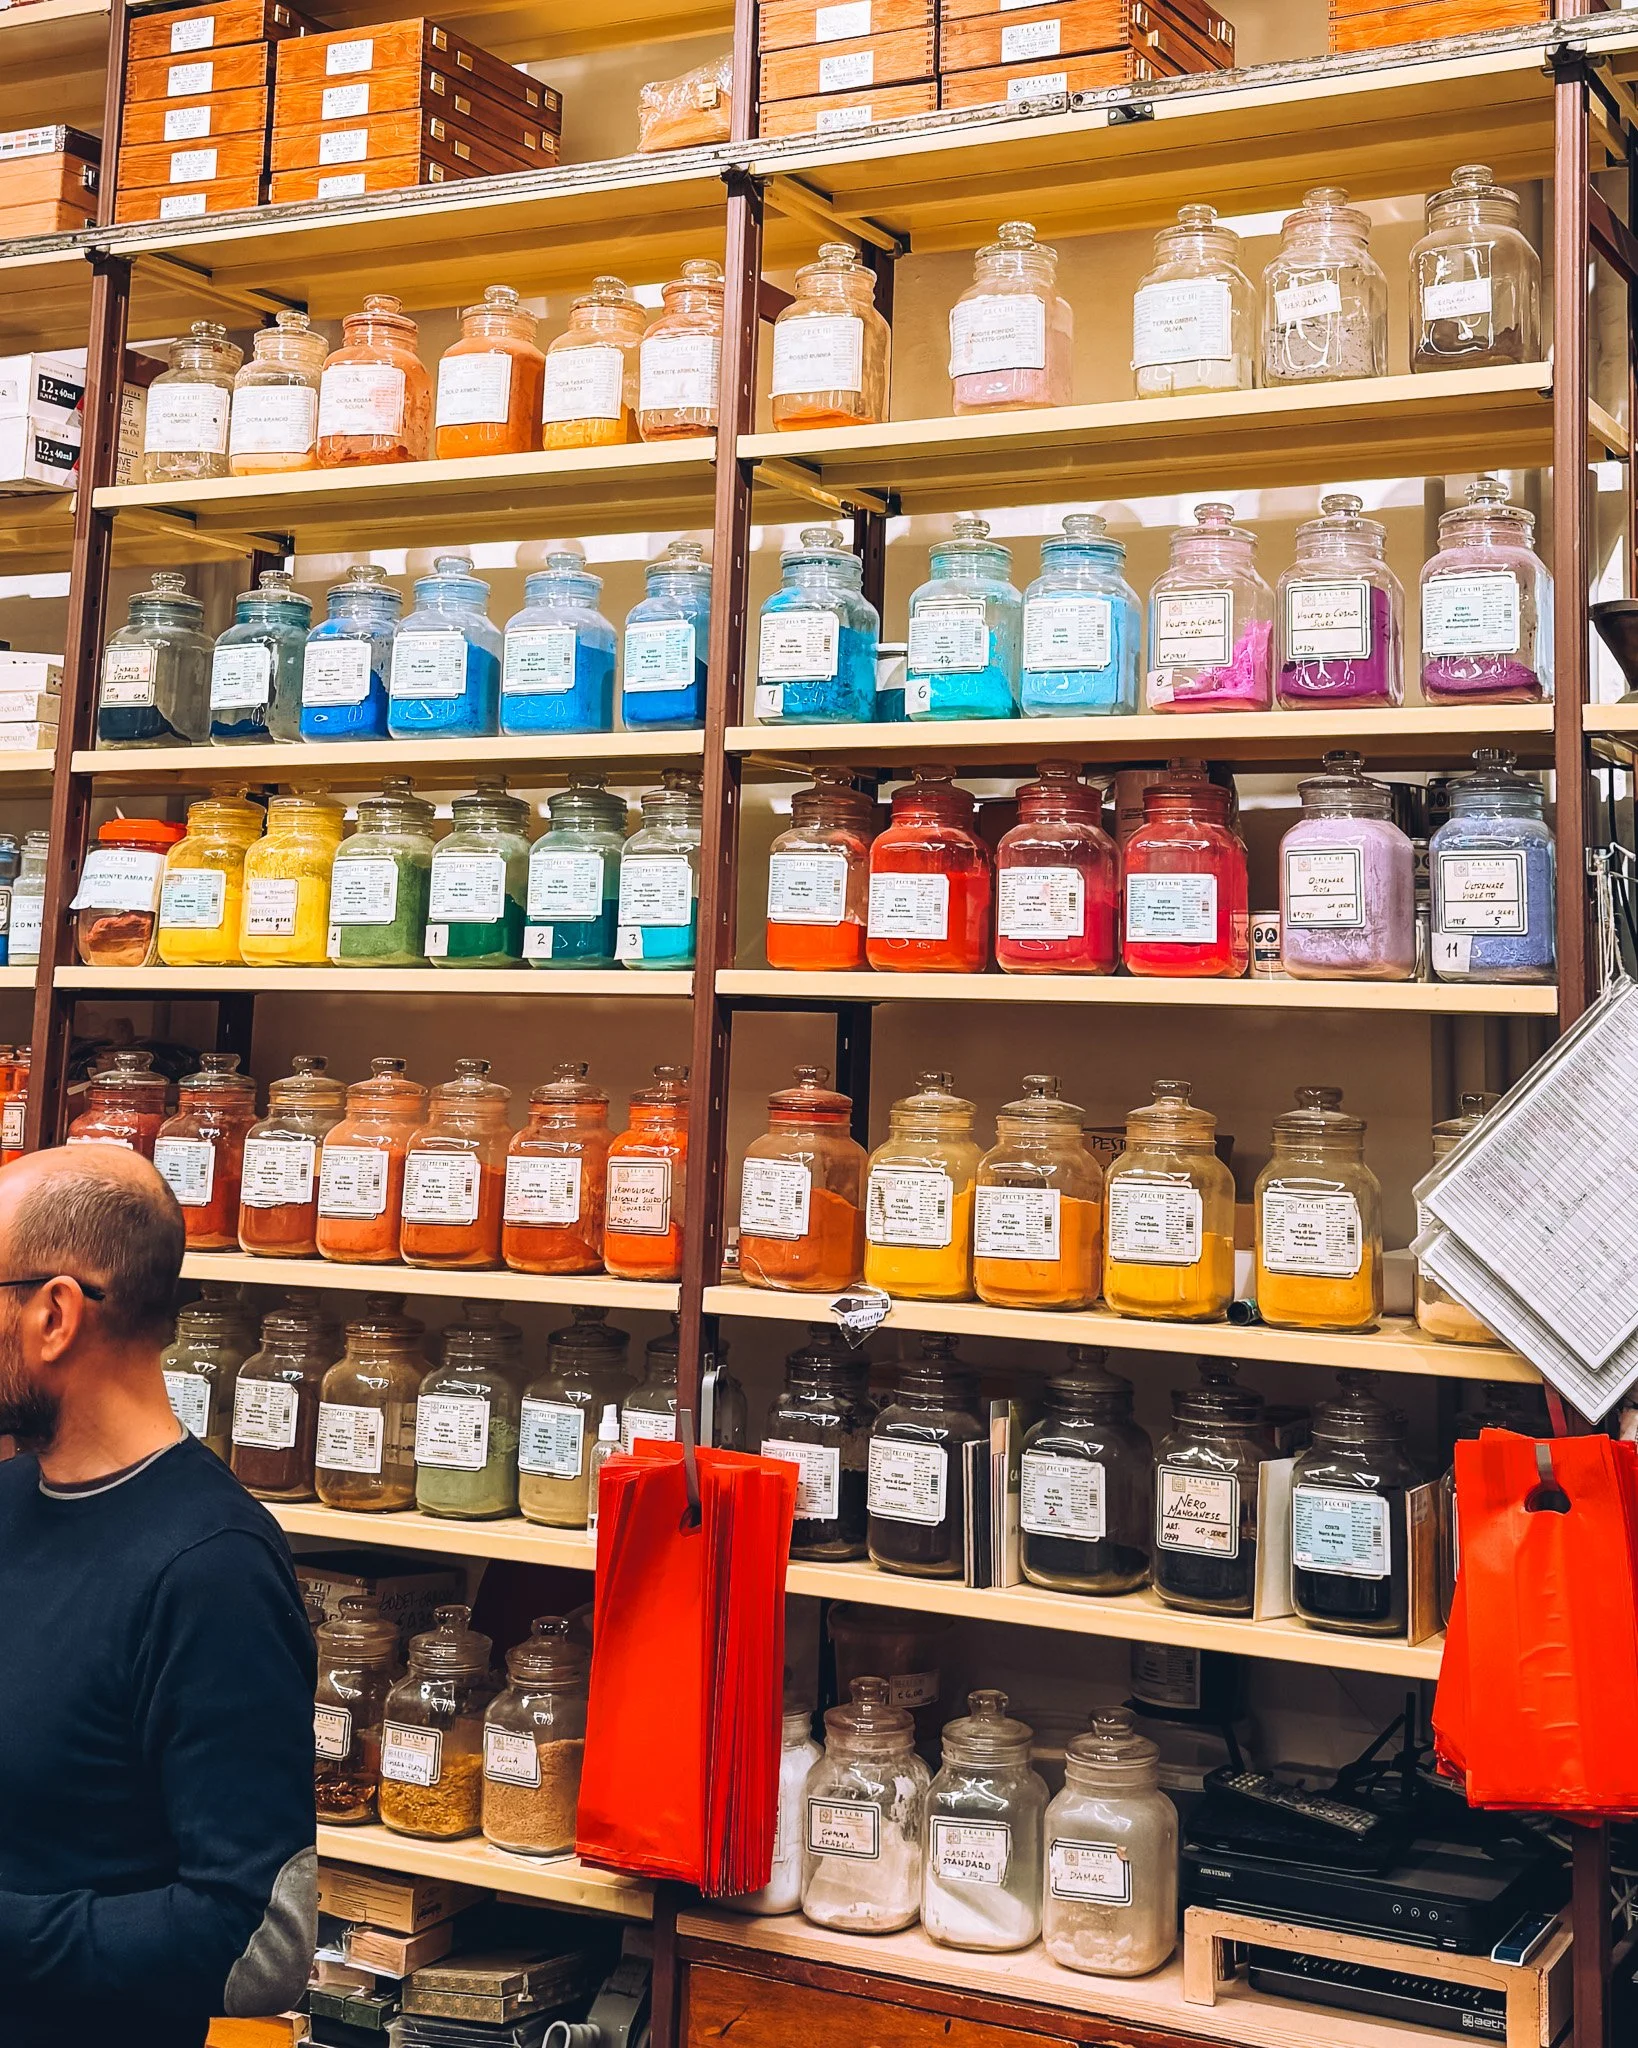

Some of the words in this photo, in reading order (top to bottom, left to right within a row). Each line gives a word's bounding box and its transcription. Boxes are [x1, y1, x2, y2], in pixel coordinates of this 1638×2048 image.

[41, 379, 54, 394] 12
[38, 440, 49, 455] 12
[1156, 674, 1164, 686] 8
[768, 690, 776, 705] 7
[918, 685, 927, 699] 6
[99, 873, 123, 881] MONTE
[124, 874, 153, 882] AMIATA
[1494, 916, 1501, 926] 5
[433, 932, 438, 944] 1
[538, 933, 545, 945] 2
[629, 934, 637, 946] 3
[1446, 942, 1459, 958] 11
[1178, 1493, 1207, 1509] NERO
[1048, 1506, 1057, 1516] 2
[1167, 1504, 1221, 1521] MANGANESE
[1166, 1522, 1180, 1530] ART.
[821, 1829, 849, 1839] GOMMA
[819, 1838, 855, 1849] ARABICA
[944, 1849, 985, 1859] CASEINA
[943, 1857, 991, 1871] STANDARD
[1069, 1870, 1106, 1883] DAMAR
